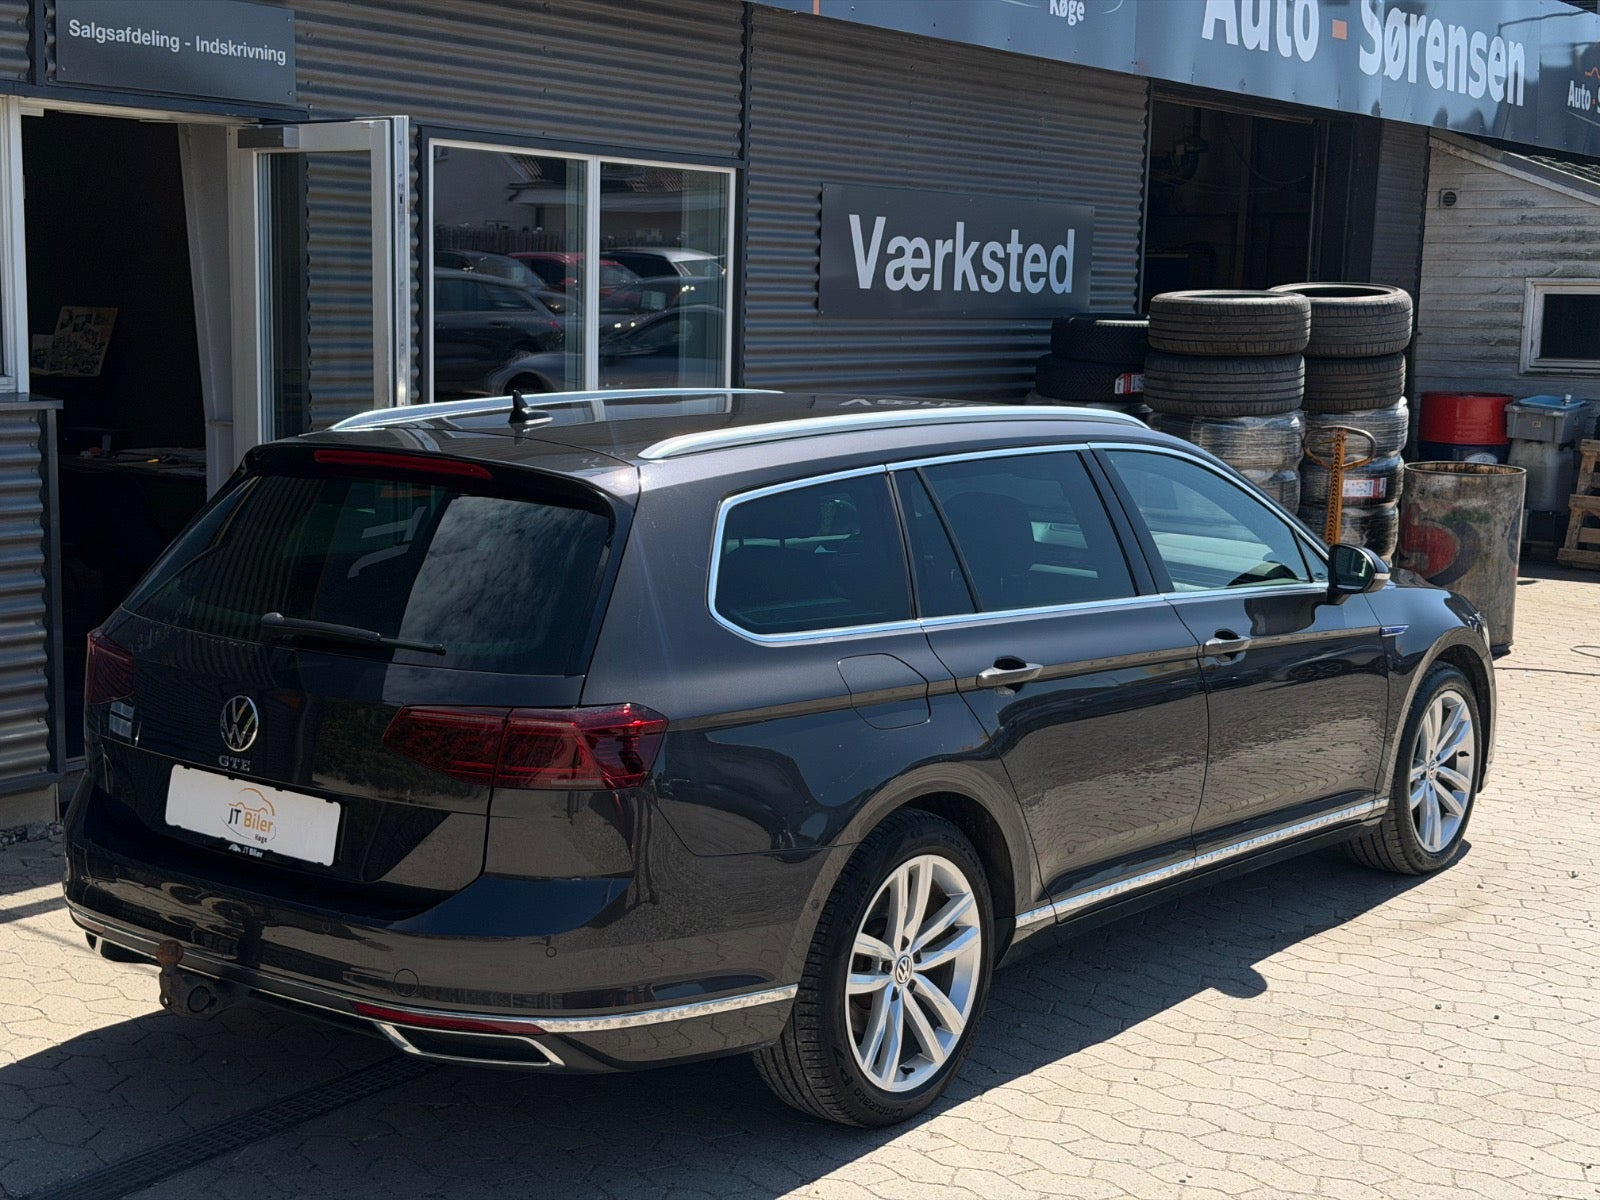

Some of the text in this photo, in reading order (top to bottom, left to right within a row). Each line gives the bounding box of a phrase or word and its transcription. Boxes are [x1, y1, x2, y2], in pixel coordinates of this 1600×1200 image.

[68, 19, 180, 52] Salgsafdeling
[196, 35, 286, 66] Indskrivning
[1359, 0, 1525, 107] Sørensen
[1567, 79, 1591, 111] Auto
[849, 214, 1076, 294] Værksted
[218, 755, 251, 772] GTE
[228, 808, 273, 833] JT Biler
